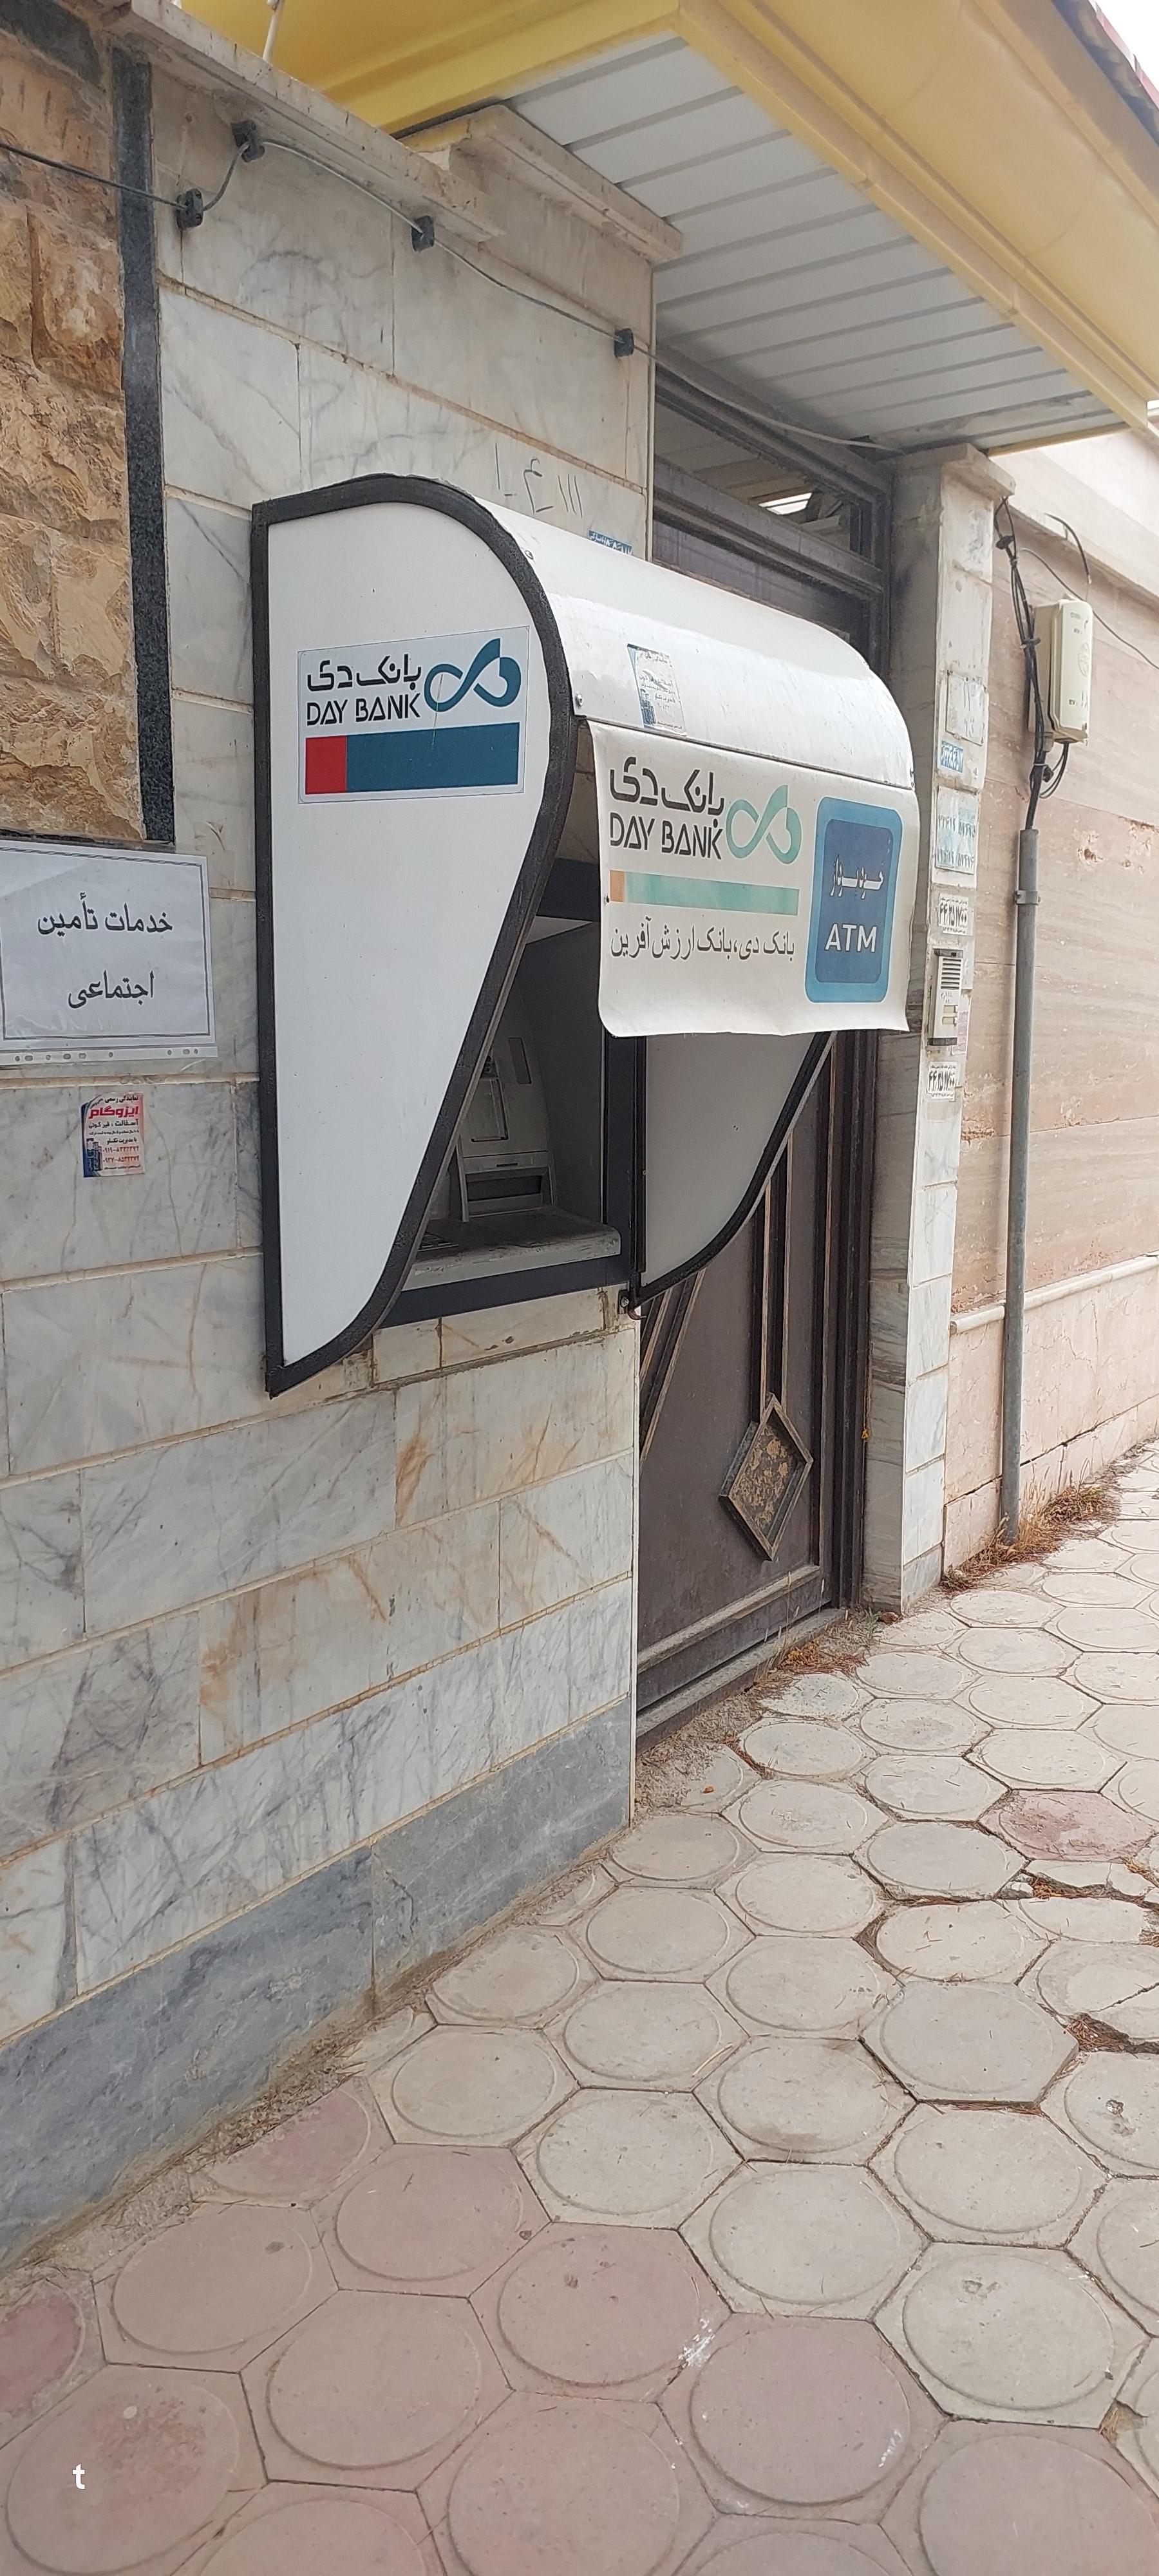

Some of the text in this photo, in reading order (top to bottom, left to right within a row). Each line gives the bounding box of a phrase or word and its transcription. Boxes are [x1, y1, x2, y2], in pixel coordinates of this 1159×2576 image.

[307, 654, 422, 692] بانک دی
[306, 692, 421, 726] DAY BANK
[610, 757, 724, 829] بانک دی
[609, 813, 724, 860] DAY BANK
[37, 891, 173, 938] خدمات تأمین
[610, 916, 652, 960] آفرین
[697, 926, 732, 960] بانک
[763, 930, 796, 962] بانک
[824, 923, 878, 953] ATM
[68, 969, 155, 1009] اجتماعی
[88, 1105, 139, 1119] ایزوگام
